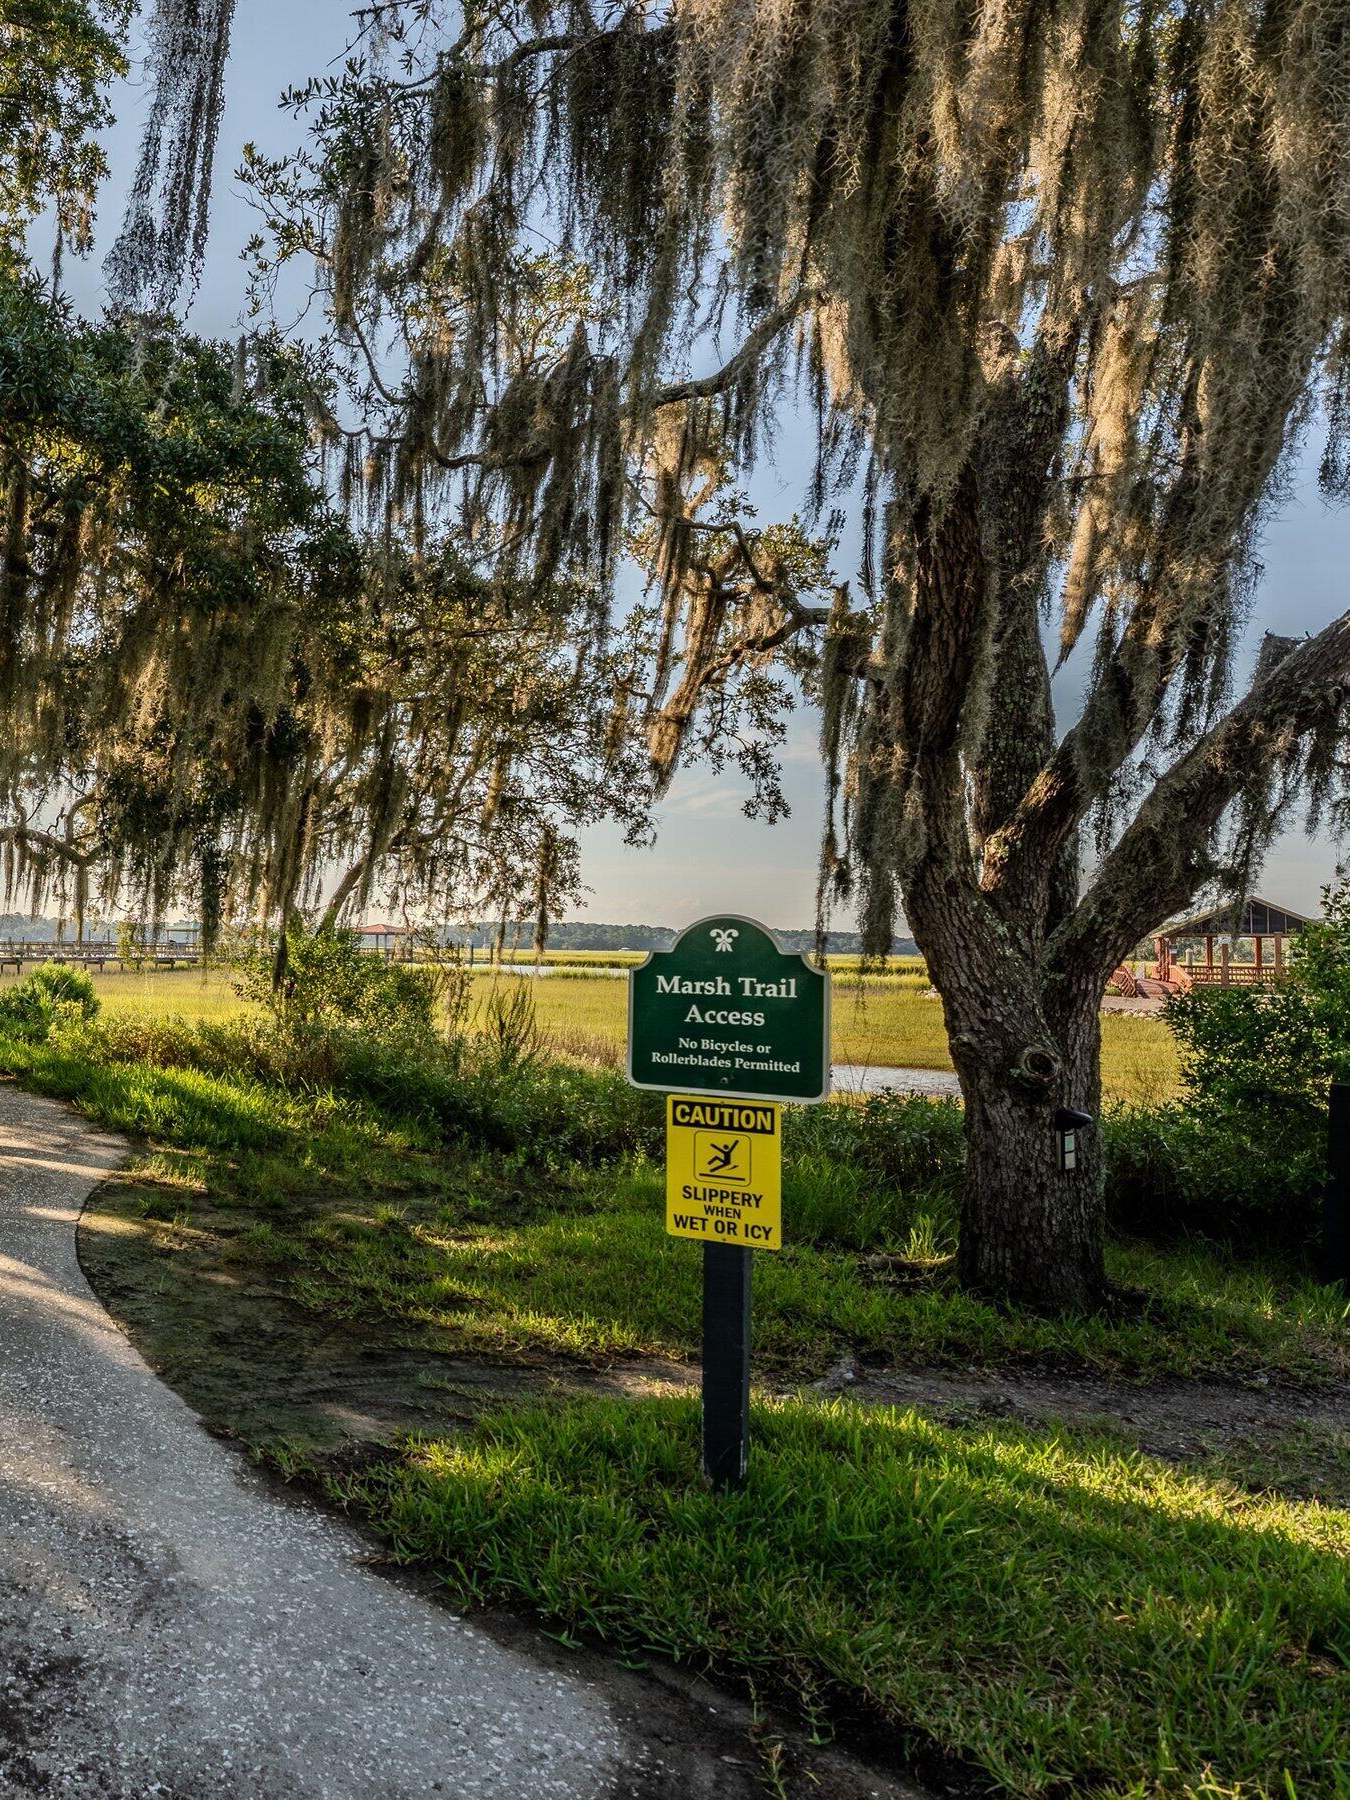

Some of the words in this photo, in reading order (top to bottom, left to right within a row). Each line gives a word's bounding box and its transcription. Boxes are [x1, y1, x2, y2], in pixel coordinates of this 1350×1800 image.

[656, 975, 732, 996] Marsh
[738, 977, 798, 998] Trail
[684, 1004, 766, 1026] Access
[678, 1037, 698, 1050] No
[701, 1039, 754, 1055] Bicycles
[756, 1044, 772, 1054] or
[651, 1052, 731, 1068] Rollerblades
[734, 1058, 800, 1073] Permitted
[675, 1104, 772, 1130] CAUTION
[682, 1185, 763, 1208] SLIPPERY
[704, 1205, 741, 1219] WHEN
[673, 1214, 709, 1232] WET
[714, 1220, 738, 1236] OR
[744, 1223, 773, 1241] ICY
